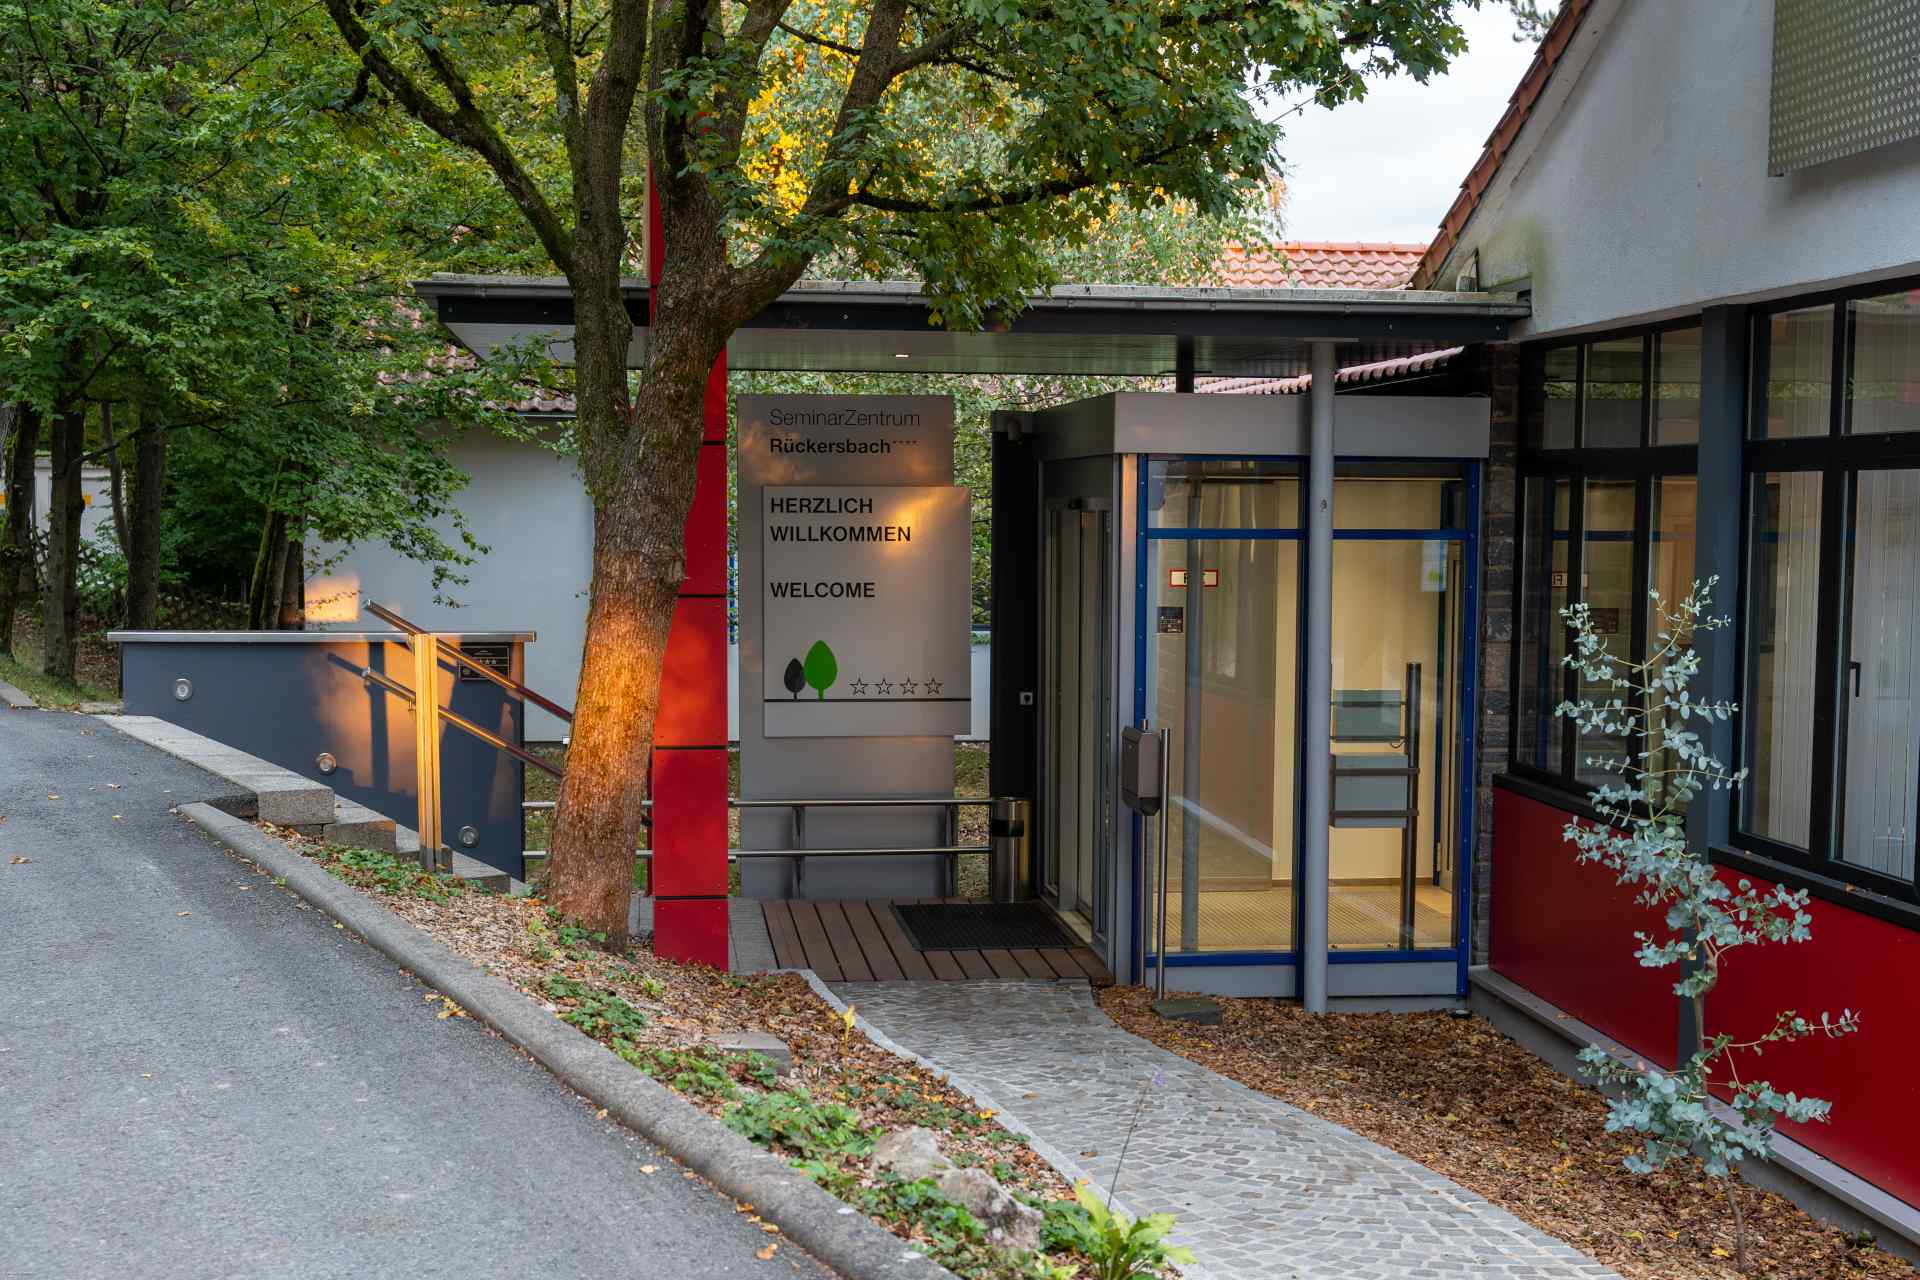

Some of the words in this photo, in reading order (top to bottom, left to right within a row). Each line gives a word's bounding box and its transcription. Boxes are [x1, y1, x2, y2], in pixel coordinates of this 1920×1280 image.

[769, 408, 921, 427] SeminarZentrum
[770, 497, 873, 514] HERZLICH
[770, 526, 912, 543] WILLKOMMEN
[770, 582, 876, 599] WELCOME
